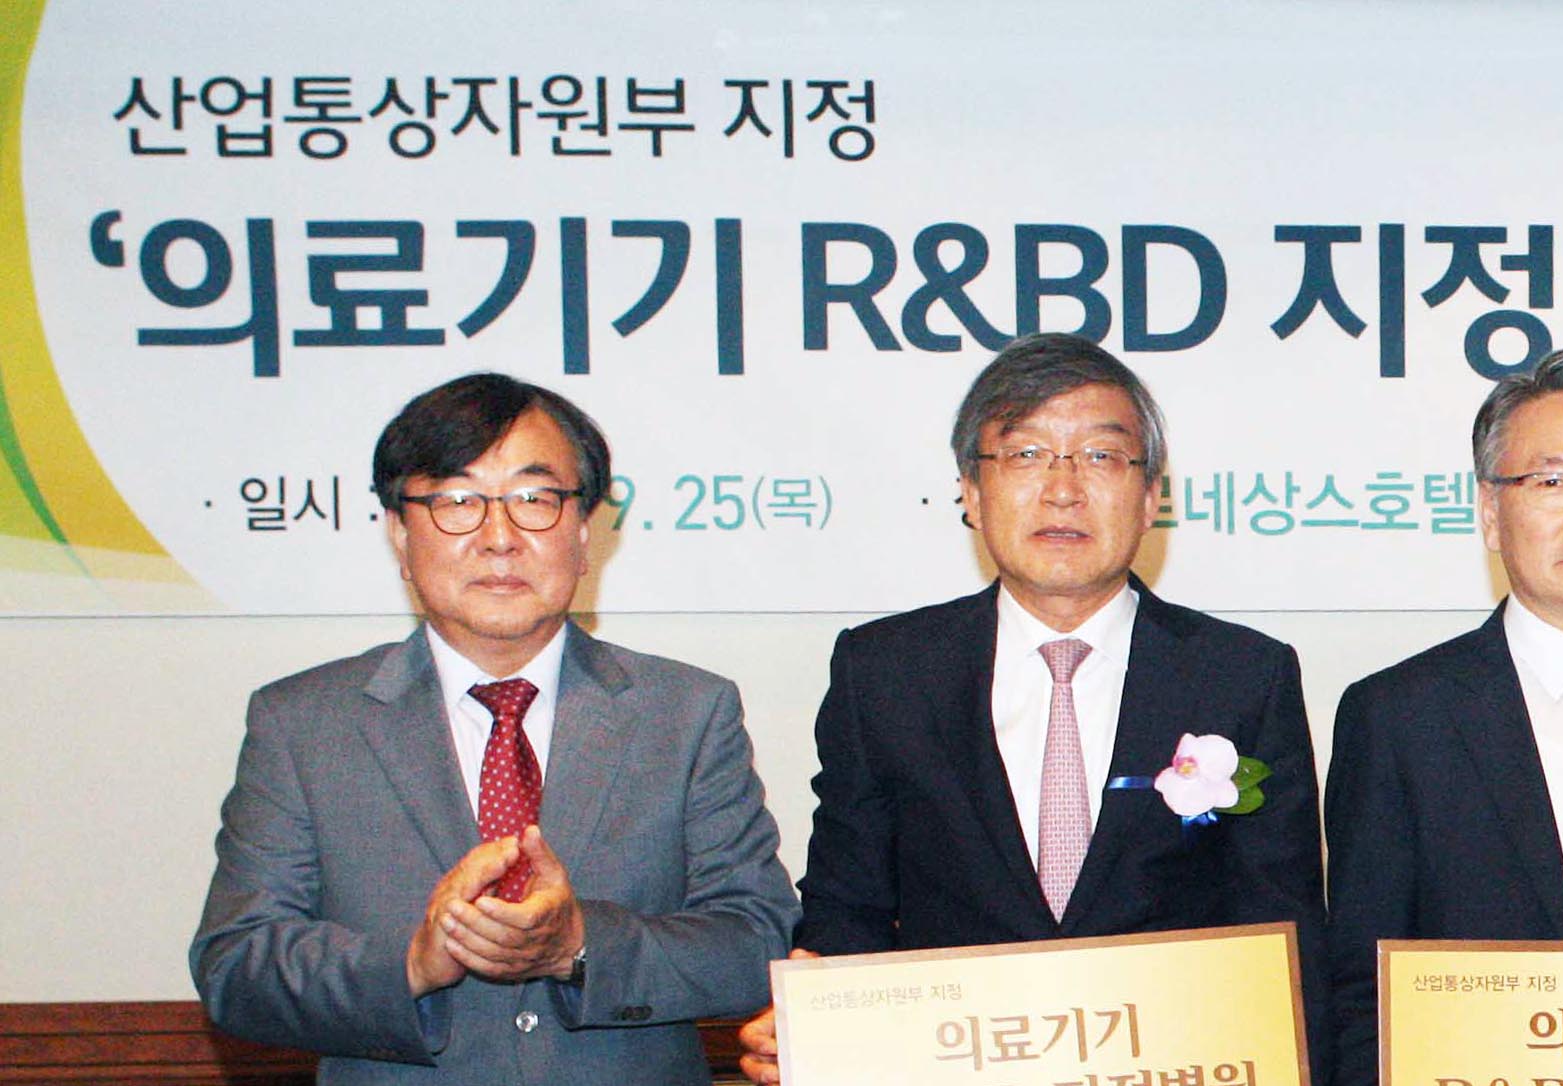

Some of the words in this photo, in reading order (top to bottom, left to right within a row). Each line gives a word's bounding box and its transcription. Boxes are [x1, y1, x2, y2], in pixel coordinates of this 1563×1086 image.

[113, 74, 695, 162] 산업통상자원부
[723, 76, 877, 162] 지정
[802, 221, 1227, 353] R&BD
[240, 475, 340, 531] 일시
[809, 983, 925, 1010] 산업통상자원부
[930, 983, 963, 1002] 지정
[1413, 974, 1521, 993] 산업통상자원부
[1527, 974, 1557, 993] 지정
[935, 1003, 1140, 1072] 의료기기
